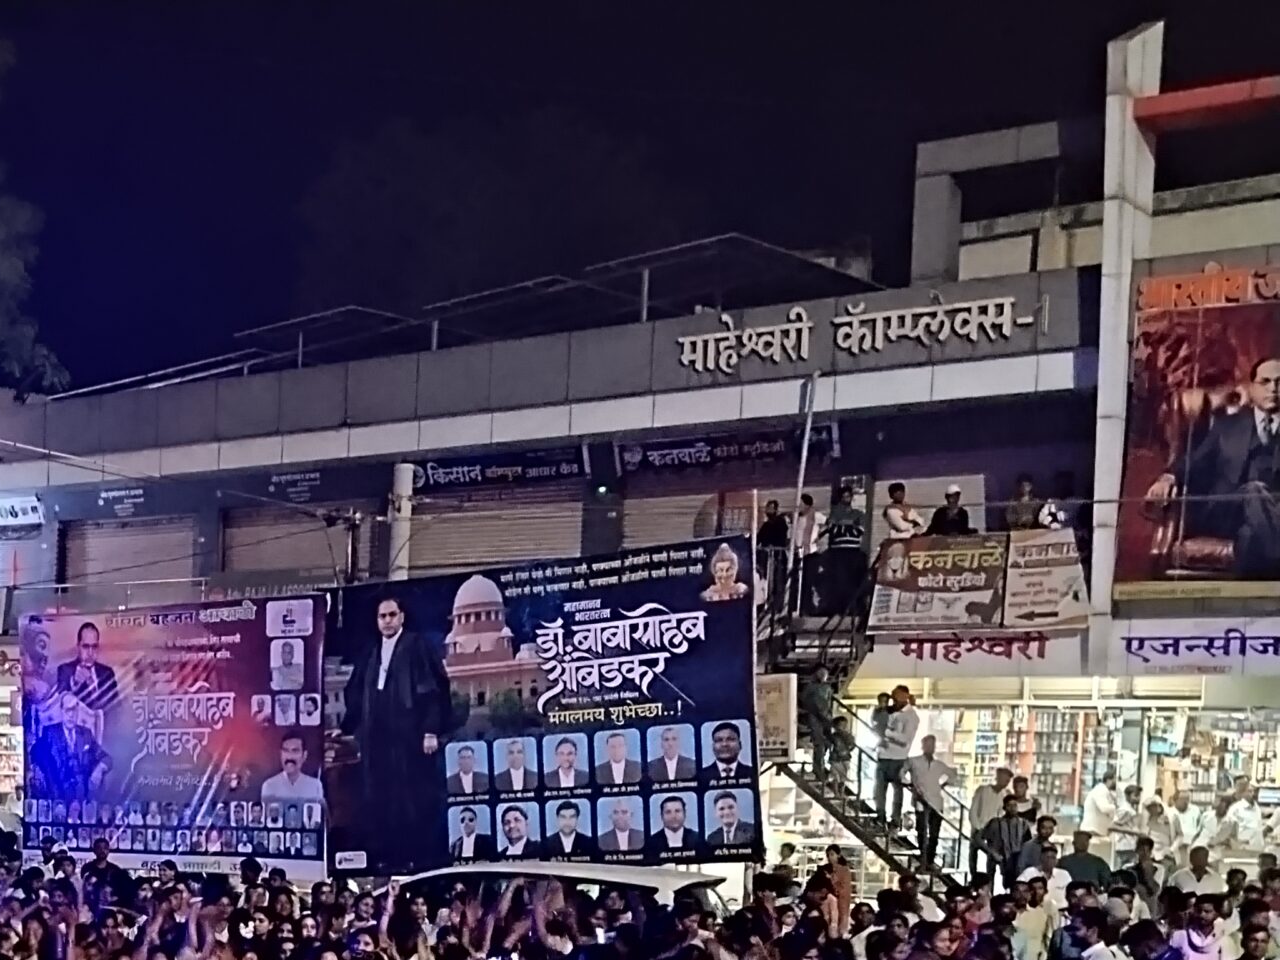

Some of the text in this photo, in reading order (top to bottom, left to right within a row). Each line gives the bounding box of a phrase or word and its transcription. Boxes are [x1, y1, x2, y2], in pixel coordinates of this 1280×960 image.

[677, 307, 814, 374] माहेश्वरी
[427, 462, 482, 486] किसान
[525, 465, 556, 479] आधार
[909, 542, 1004, 570] कनवाळे
[918, 571, 943, 588] फोटो
[563, 599, 601, 612] महामानव
[575, 608, 611, 622] भारतरत्न
[150, 611, 195, 628] बहुजन
[898, 631, 1050, 664] माहेश्वरी
[537, 651, 671, 708] आंबेडकर
[548, 707, 605, 725] मंगलमय
